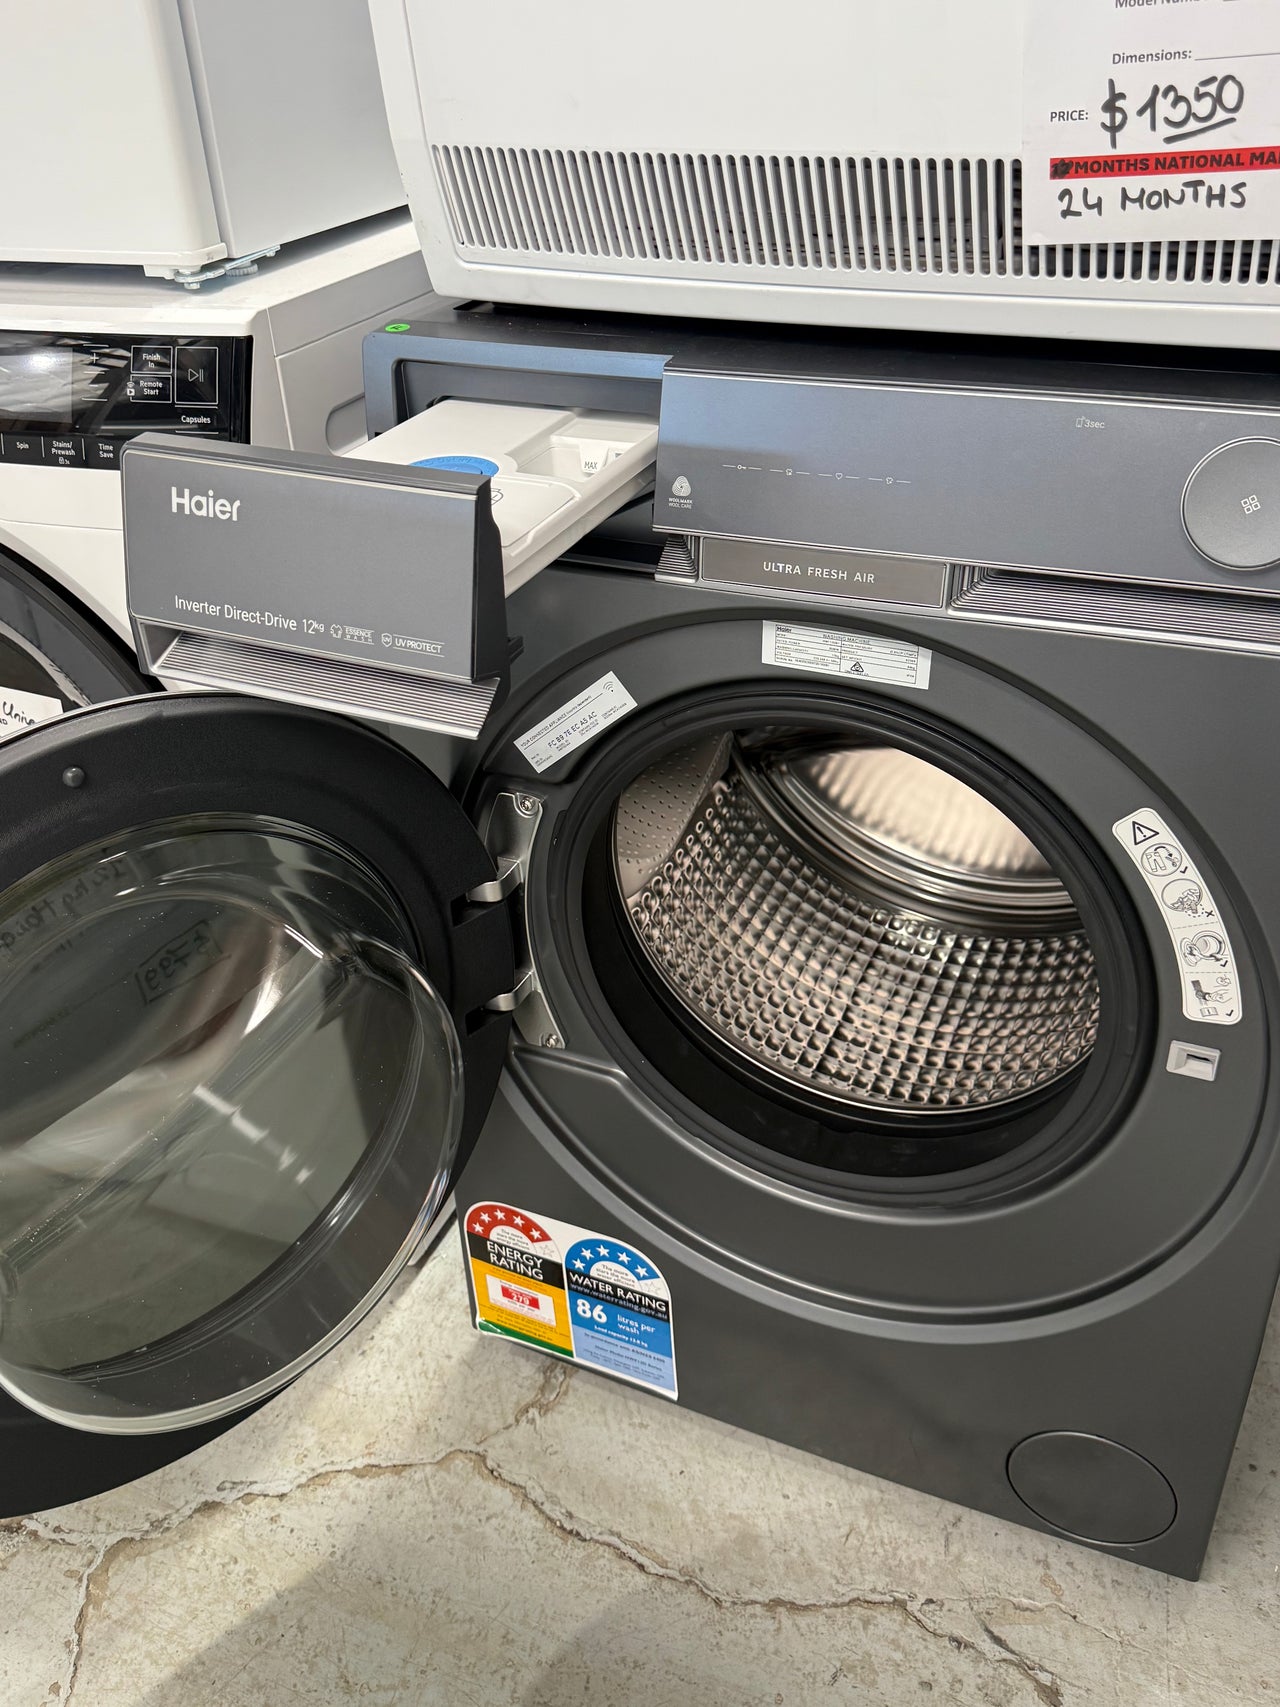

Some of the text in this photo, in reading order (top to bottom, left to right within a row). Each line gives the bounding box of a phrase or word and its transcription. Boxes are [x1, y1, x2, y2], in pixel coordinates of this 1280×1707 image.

[1112, 50, 1192, 65] Dimensions:
[1050, 110, 1089, 123] PRICE:
[1075, 158, 1150, 174] MONTHS
[1154, 152, 1245, 170] NATIONAL
[1250, 149, 1280, 165] MA
[1058, 180, 1248, 219] 24 MONTHS
[142, 353, 161, 361] Finish
[139, 380, 163, 388] Remote
[181, 415, 211, 424] Capsules
[1084, 419, 1105, 429] 3sec
[16, 442, 29, 450] Spin
[52, 440, 73, 449] Stains/
[98, 443, 114, 451] Time
[51, 447, 76, 456] Prewash
[584, 461, 598, 470] MAX
[171, 486, 241, 521] Haier
[763, 561, 875, 583] ULTRA FRESH AIR
[174, 595, 325, 634] Inverter Direct-Drive 12kg
[345, 627, 372, 638] ESSENCE
[395, 638, 442, 653] UV PROTECT
[487, 1240, 543, 1268] ENERGY
[490, 1252, 543, 1280] RATING
[569, 1272, 613, 1295] WATER
[616, 1287, 666, 1312] RATING
[577, 1298, 655, 1333] 86 litres per
[618, 1323, 640, 1335] wash
